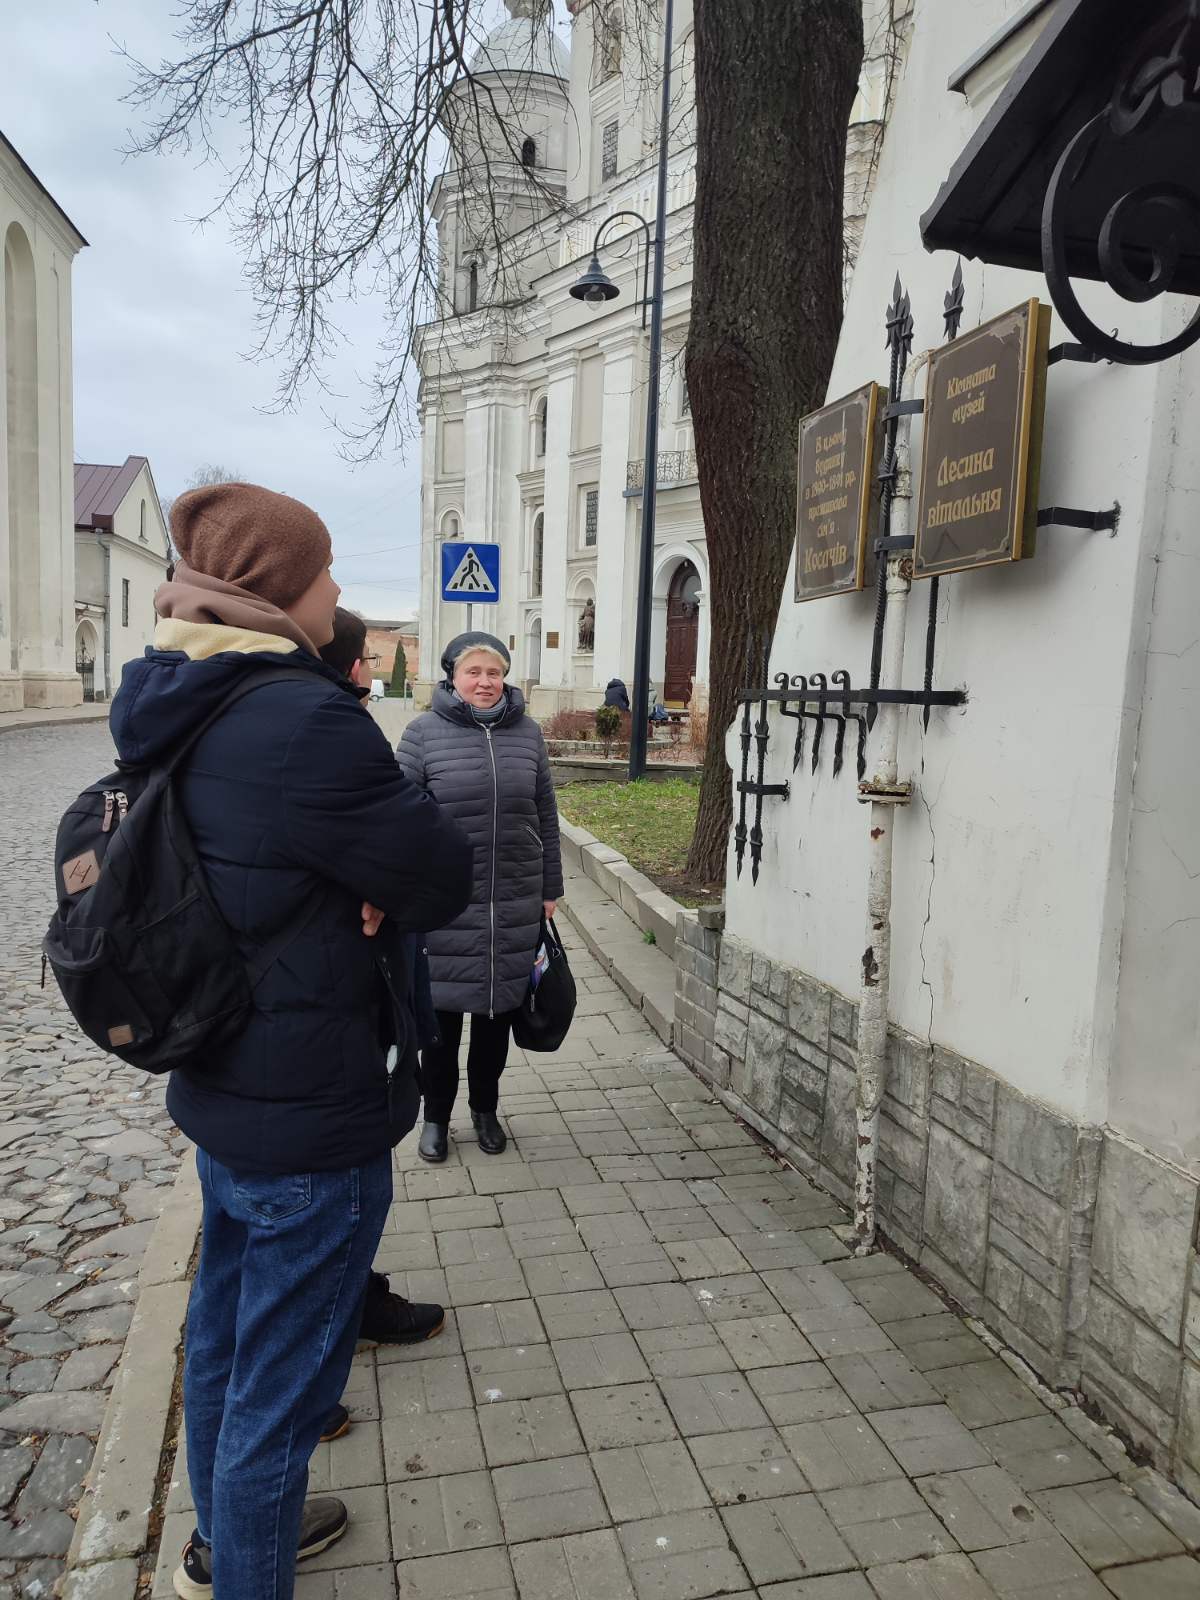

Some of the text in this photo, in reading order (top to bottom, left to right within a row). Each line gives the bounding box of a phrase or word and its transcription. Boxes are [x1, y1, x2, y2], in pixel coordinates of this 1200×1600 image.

[947, 363, 997, 400] Кімната
[952, 390, 985, 424] музей
[815, 435, 822, 454] В
[937, 447, 995, 488] Лесина
[927, 487, 1002, 529] вітальня
[804, 541, 848, 574] Косачів
